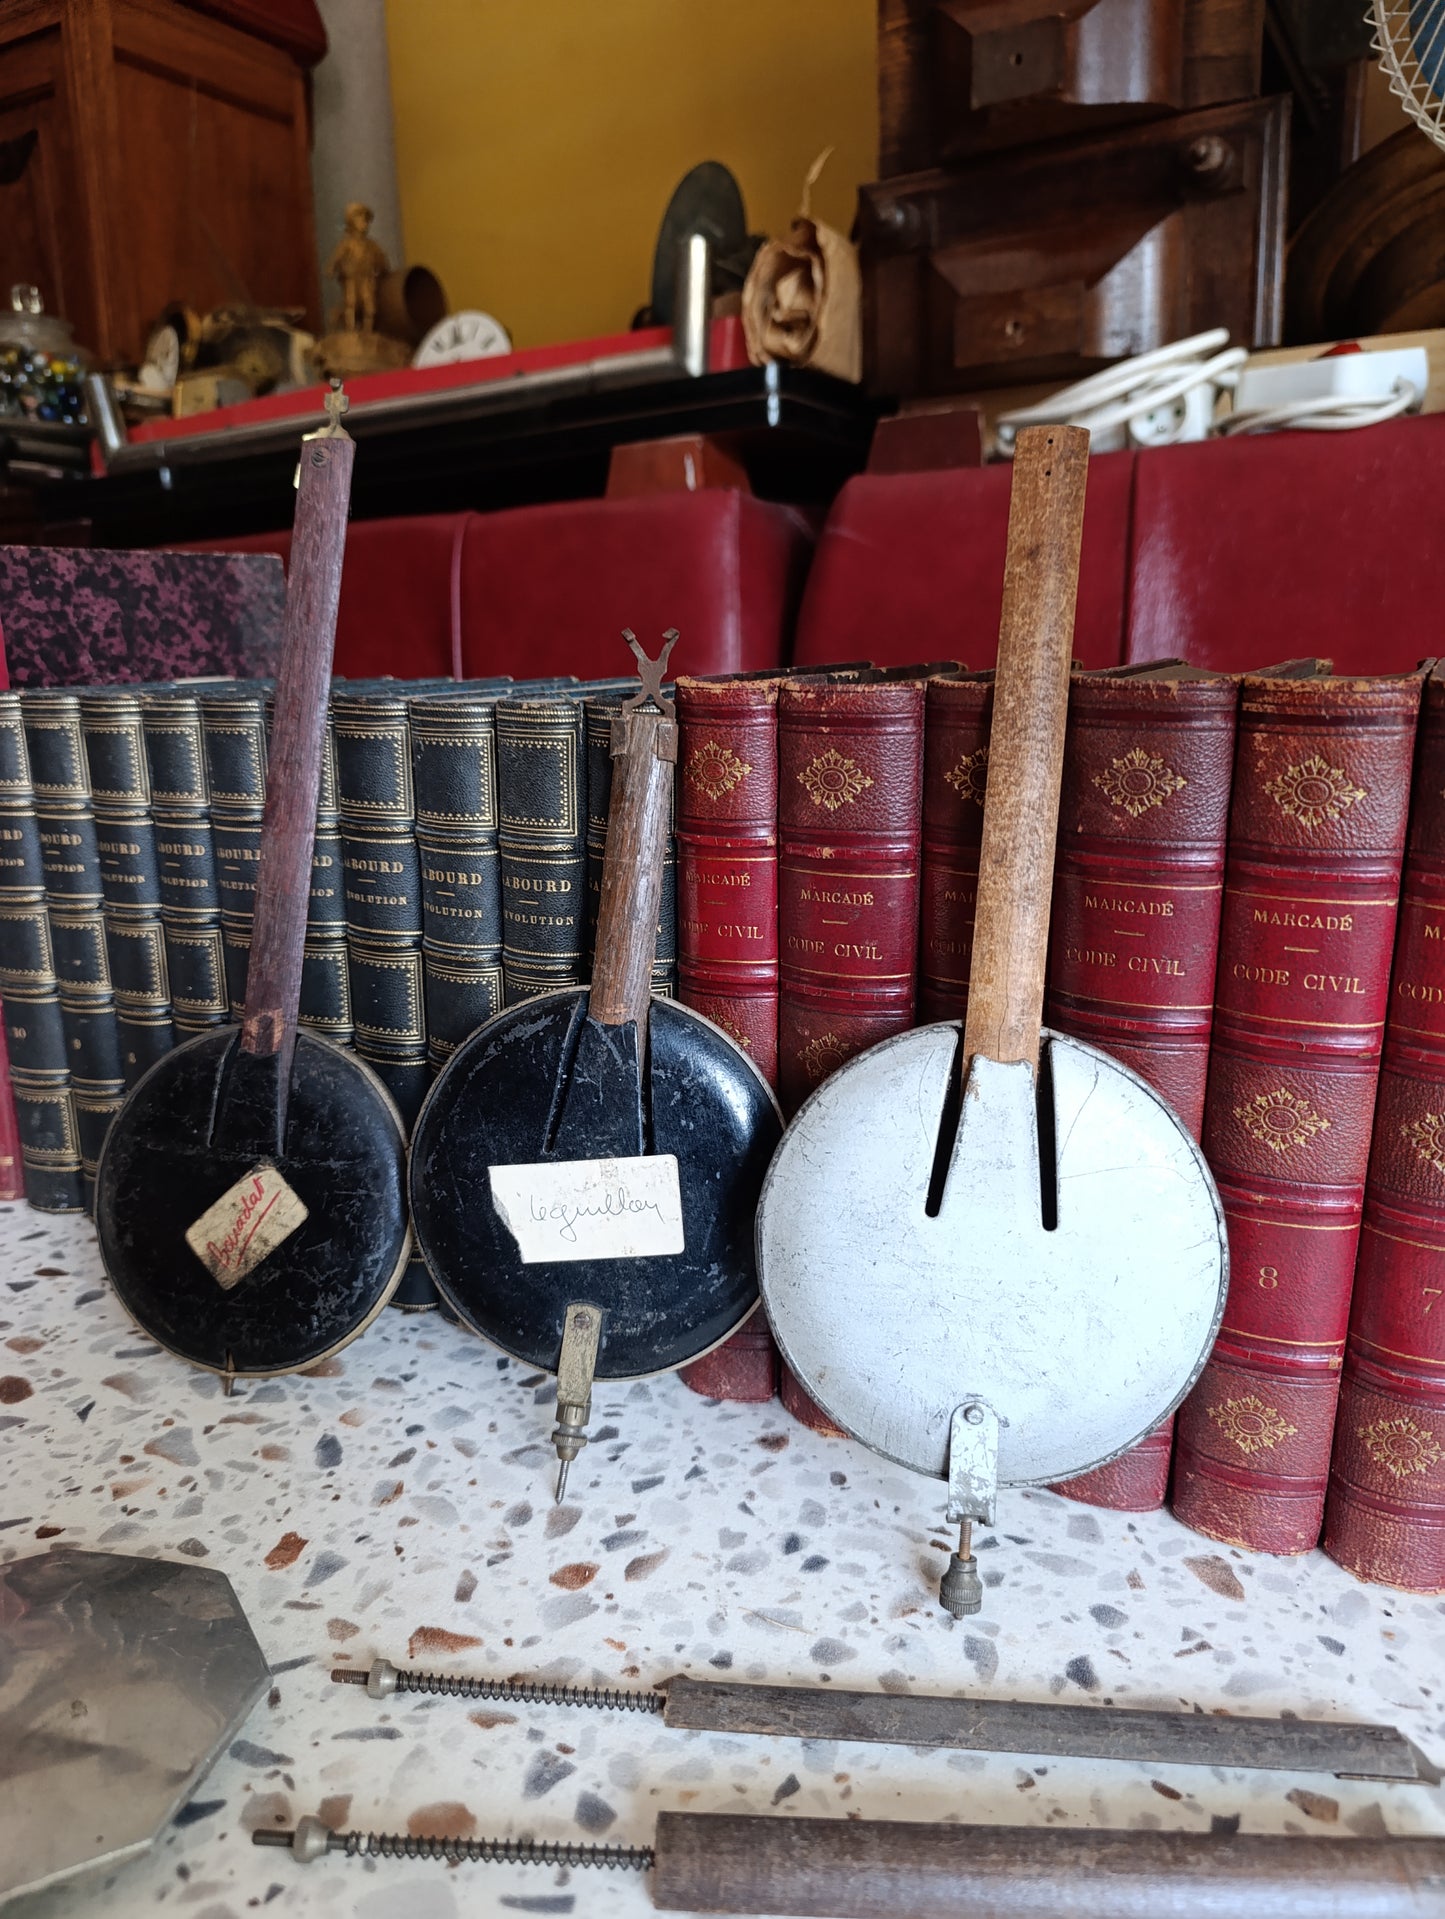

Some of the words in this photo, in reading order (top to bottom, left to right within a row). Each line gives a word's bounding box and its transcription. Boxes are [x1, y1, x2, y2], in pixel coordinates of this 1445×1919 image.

[800, 888, 874, 906] MARCADÉ
[1084, 895, 1174, 917] MARCADÉ
[1253, 909, 1353, 931] MARCADÉ
[717, 924, 764, 940] CIVIL
[788, 935, 825, 954] CODE
[834, 943, 883, 960] CIVIL
[1066, 948, 1116, 968] CODE
[1128, 956, 1185, 977] CIVIL
[1233, 962, 1290, 986] CODE
[1303, 973, 1366, 994] CIVIL
[1398, 981, 1445, 1004] COD
[1258, 1266, 1278, 1289] 8
[1422, 1287, 1443, 1314] 7
